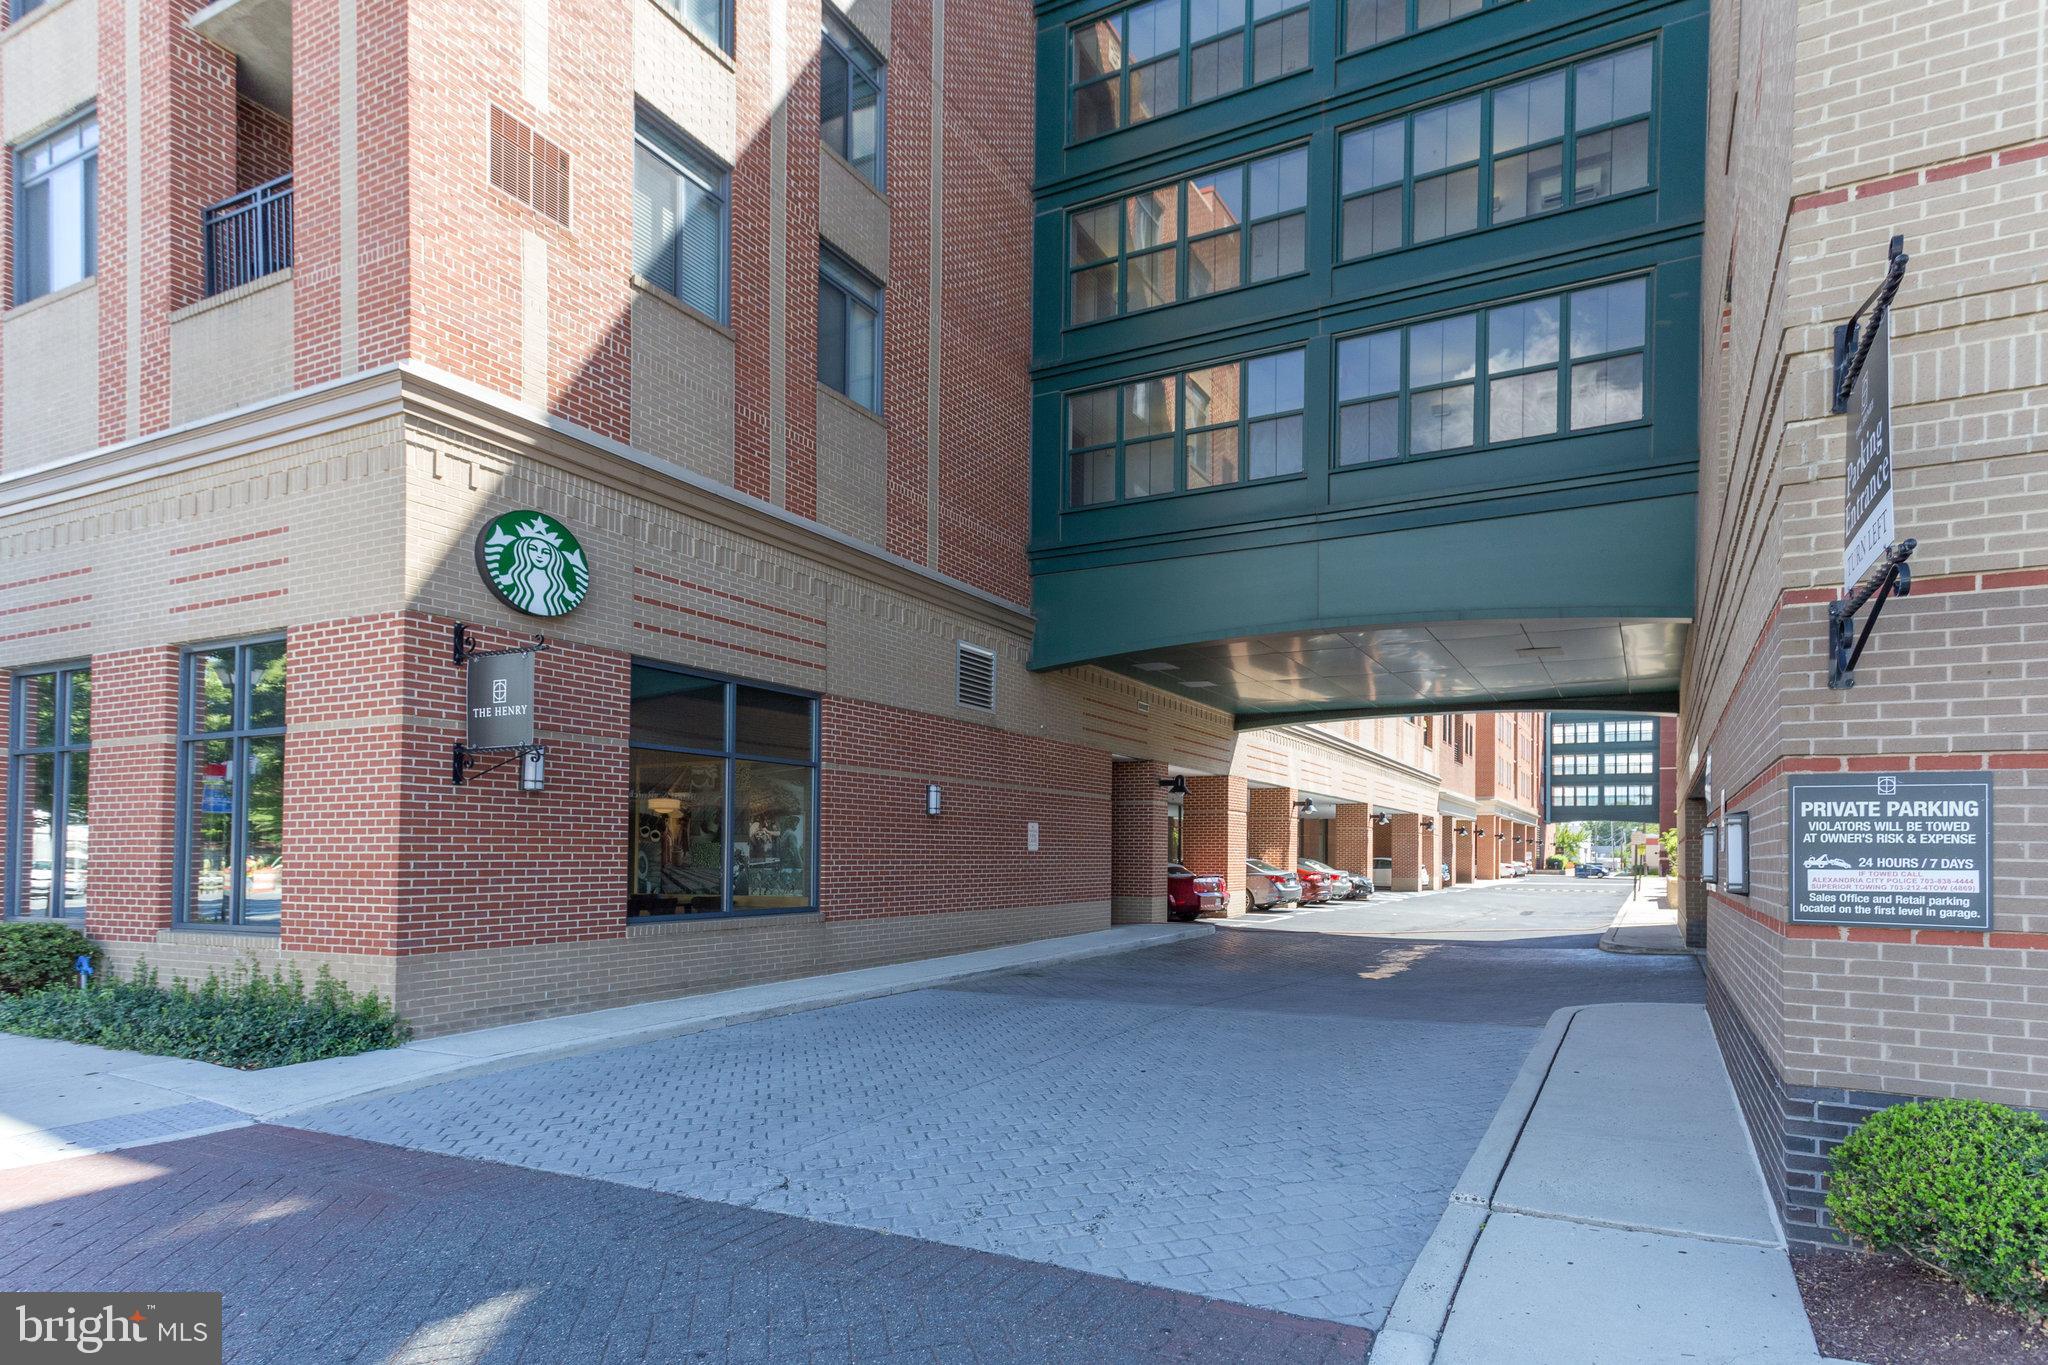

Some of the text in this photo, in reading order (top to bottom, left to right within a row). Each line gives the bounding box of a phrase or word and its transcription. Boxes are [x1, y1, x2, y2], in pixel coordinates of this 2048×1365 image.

[1847, 417, 1883, 497] Parking
[1846, 456, 1889, 537] Entrance
[1847, 508, 1887, 576] TURN LEFT
[473, 704, 528, 718] THE HENRY
[1801, 800, 1979, 817] PRIVATE PARKING
[1808, 821, 1970, 832] VIOLATORS WILL BE TOWED
[1803, 833, 1976, 844] AT OWNER'S RISK & EXPENSE
[1858, 857, 1974, 869] 24 HOURS / 7 DAYS
[1809, 893, 1970, 908] Sales Office and Retail parking
[1800, 903, 1981, 920] located on the first level in garage.
